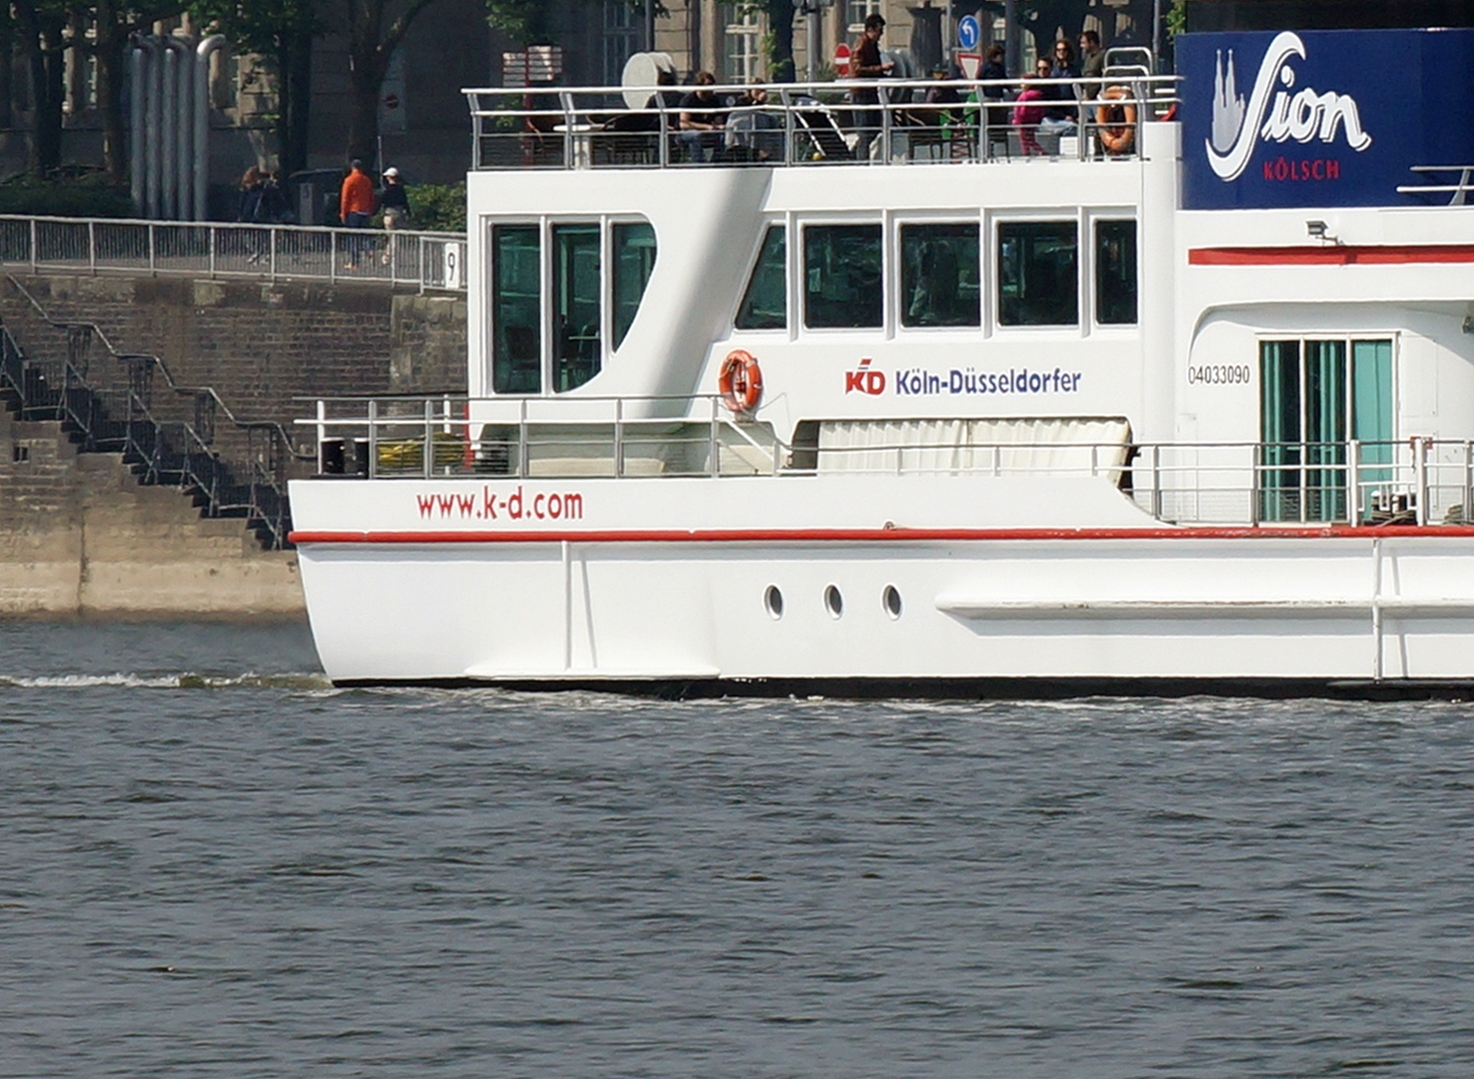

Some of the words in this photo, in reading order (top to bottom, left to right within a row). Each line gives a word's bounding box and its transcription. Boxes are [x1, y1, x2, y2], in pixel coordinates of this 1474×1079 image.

[1205, 30, 1372, 182] Sion
[845, 371, 886, 395] KD
[895, 367, 1082, 395] Köln-Düsseldorfer
[1188, 365, 1250, 384] 04033090
[416, 484, 583, 520] www.k-d.com
